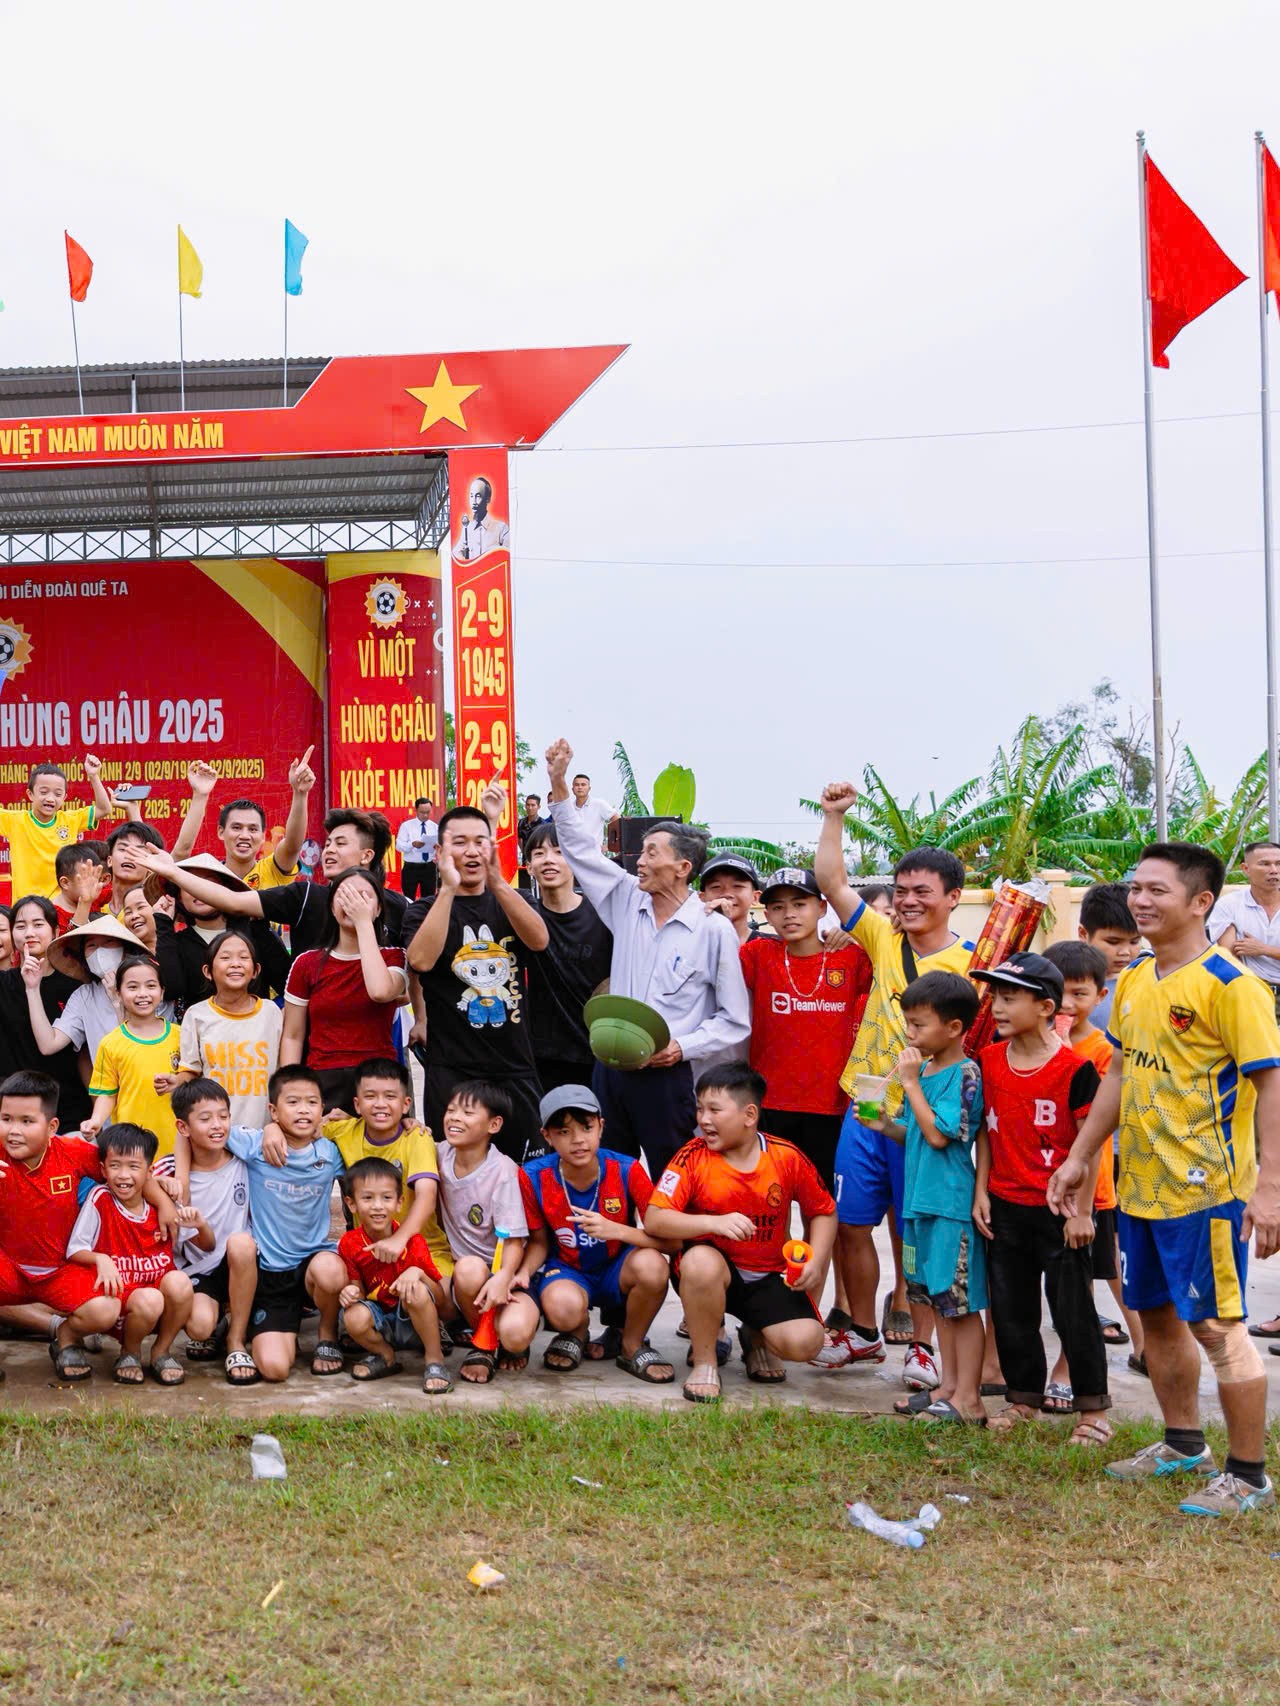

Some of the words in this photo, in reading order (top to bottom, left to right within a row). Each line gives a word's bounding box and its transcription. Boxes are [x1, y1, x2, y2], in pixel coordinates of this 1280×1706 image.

[0, 423, 42, 459] VIỆT
[48, 426, 97, 453] NAM
[104, 418, 167, 452] MUÔN
[173, 417, 224, 449] NĂM
[11, 579, 42, 599] DIỄN
[45, 579, 77, 598] ĐOÀI
[80, 579, 107, 597] QUÊ
[110, 581, 129, 596] TA
[461, 588, 505, 639] 2-9
[357, 631, 376, 679] VÌ
[379, 630, 416, 685] MỘT
[461, 647, 506, 697] 1945
[0, 694, 70, 748] HÙNG
[80, 691, 150, 745] CHÂU
[159, 698, 225, 744] 2025
[340, 696, 387, 744] HÙNG
[390, 695, 437, 743] CHÂU
[464, 720, 508, 771] 2-9
[125, 761, 142, 781] 2/9
[144, 760, 193, 782] (02/9/19
[340, 757, 385, 809] KHỎE
[389, 768, 440, 815] MẠNH
[145, 799, 170, 819] 2025
[466, 779, 510, 829] 205
[791, 997, 846, 1013] TeamViewer
[204, 1039, 269, 1069] MISS
